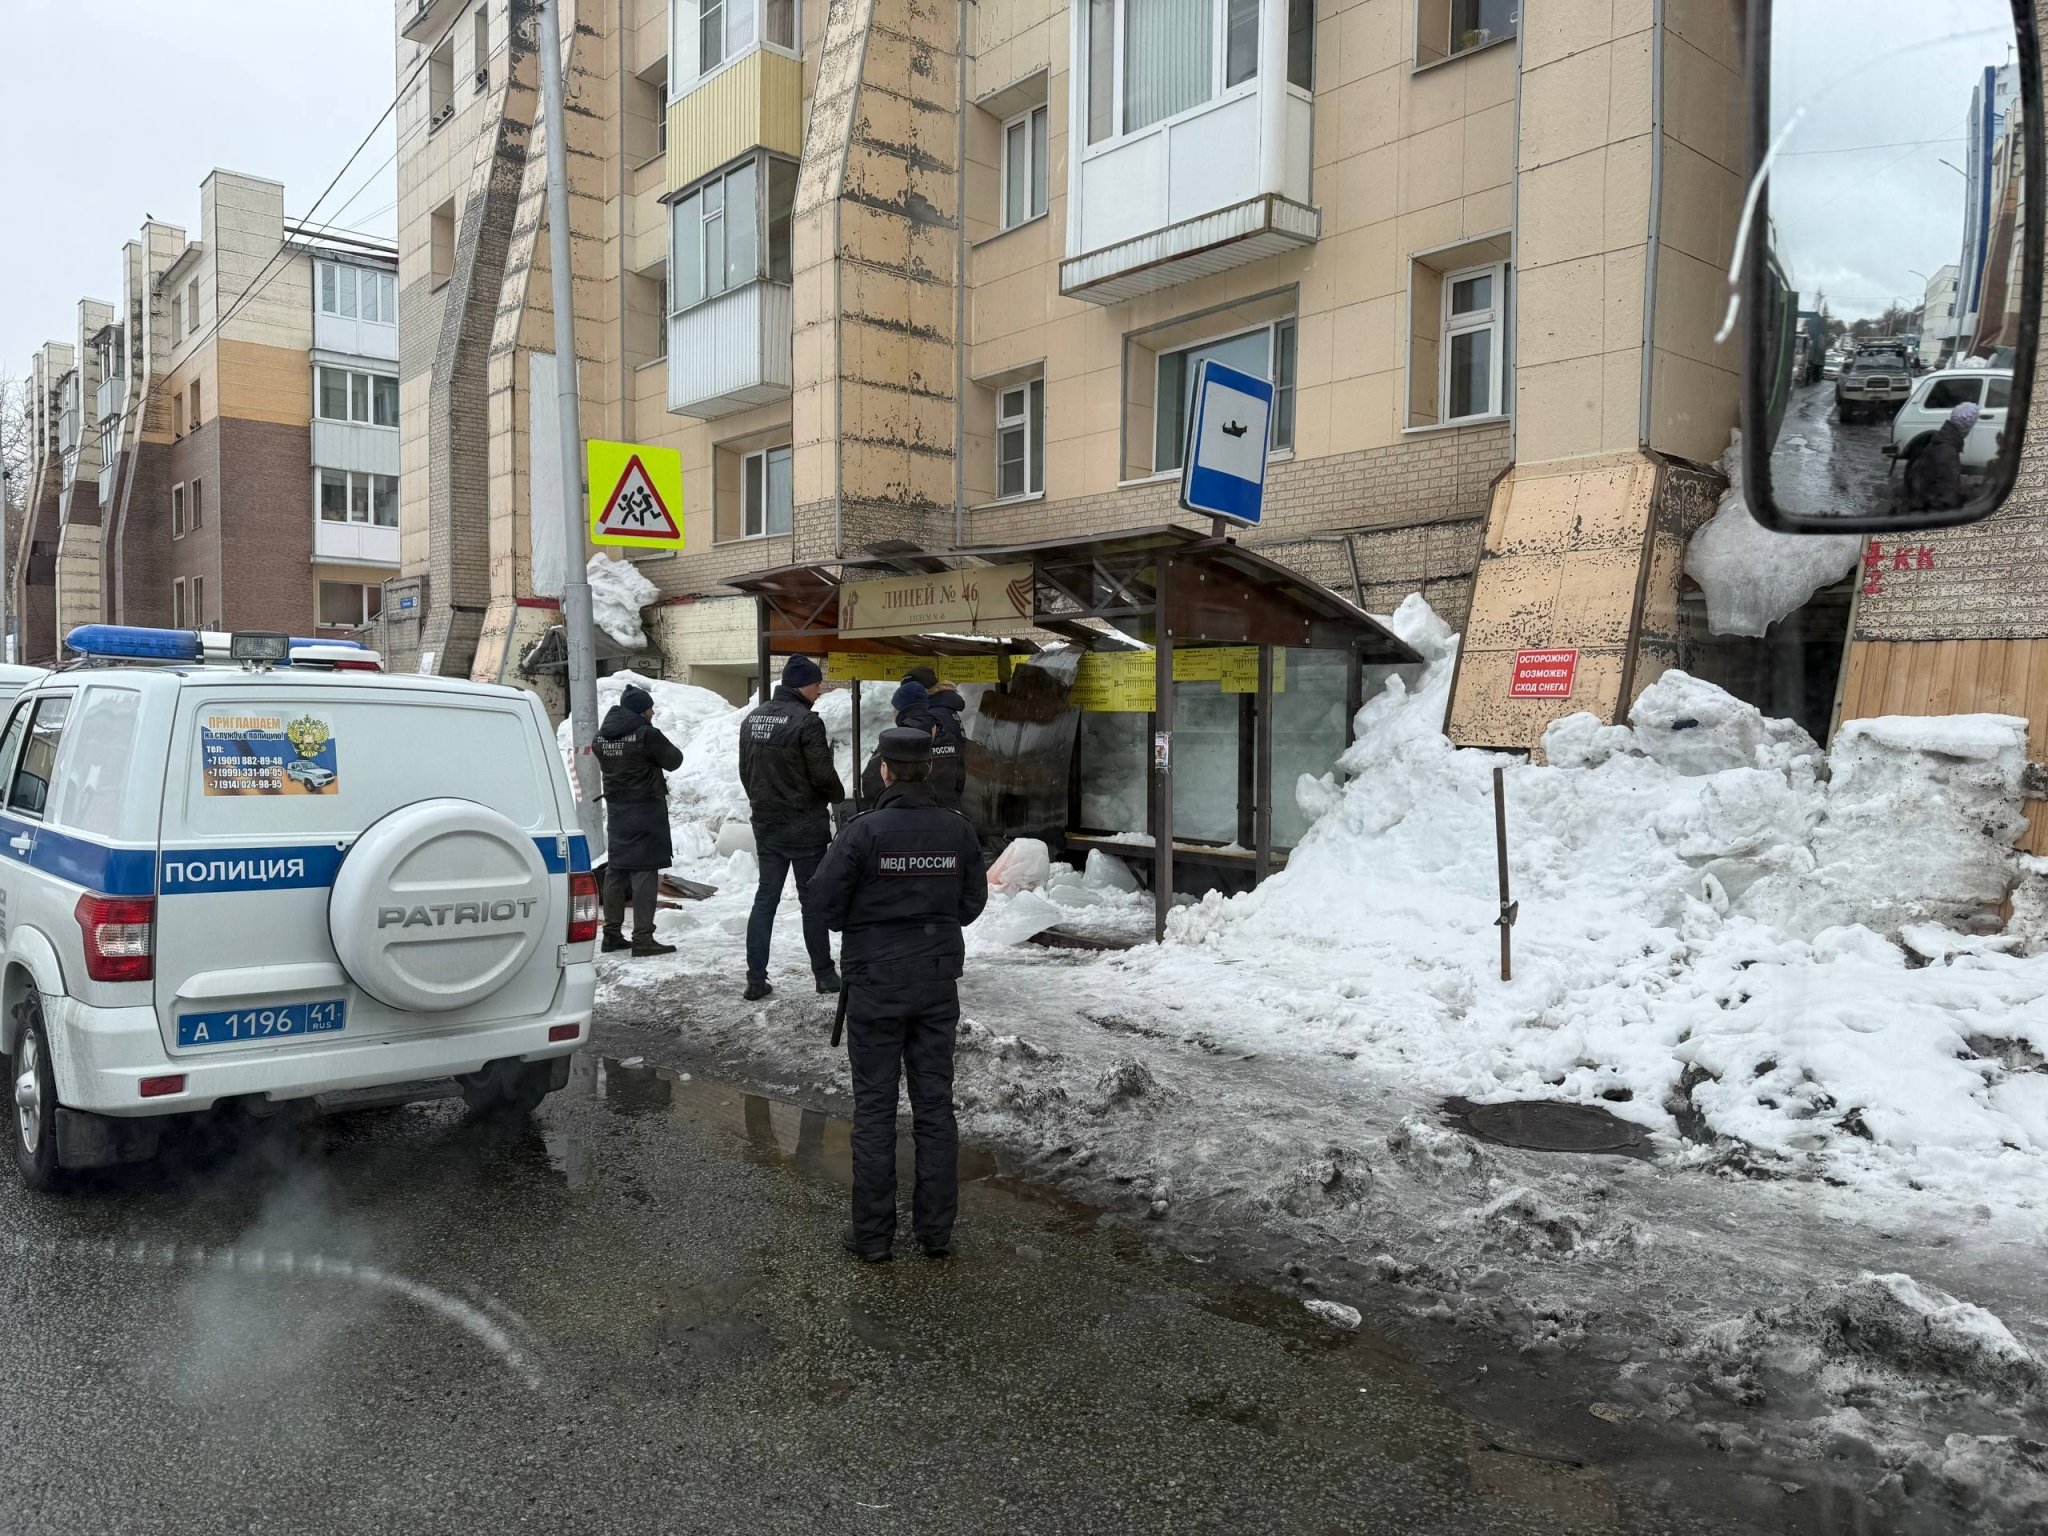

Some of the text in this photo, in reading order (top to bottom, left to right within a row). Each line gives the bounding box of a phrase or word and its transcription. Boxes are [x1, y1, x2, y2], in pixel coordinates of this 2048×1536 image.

[882, 582, 979, 610] ЛИЦЕЙ № 46
[1519, 654, 1573, 663] ОСТОРОЖНО!
[1519, 670, 1568, 678] ВОЗМОЖЕН
[1515, 683, 1568, 692] СХОД СНЕГА!
[209, 716, 281, 729] ПРИГЛАШАЕМ
[751, 724, 775, 732] КОМИТЕТ
[204, 731, 285, 742] на службу в полицию!
[751, 731, 771, 739] РОССИИ
[206, 745, 224, 753] тел:
[602, 742, 625, 750] КОМИТЕТ
[931, 746, 956, 755] РОССИИ
[207, 757, 219, 765] +7
[241, 756, 283, 765] 882-89-48
[208, 769, 219, 777] +7
[242, 768, 283, 777] 331-90-05
[209, 781, 219, 789] +7
[241, 780, 282, 789] 024-98-95
[880, 856, 956, 871] МВД РОССИИ
[165, 858, 304, 882] ПОЛИЦИЯ
[378, 896, 537, 929] PATRIOT
[225, 1009, 292, 1037] 1196
[310, 1003, 336, 1021] 41
[312, 1021, 332, 1030] RUS
